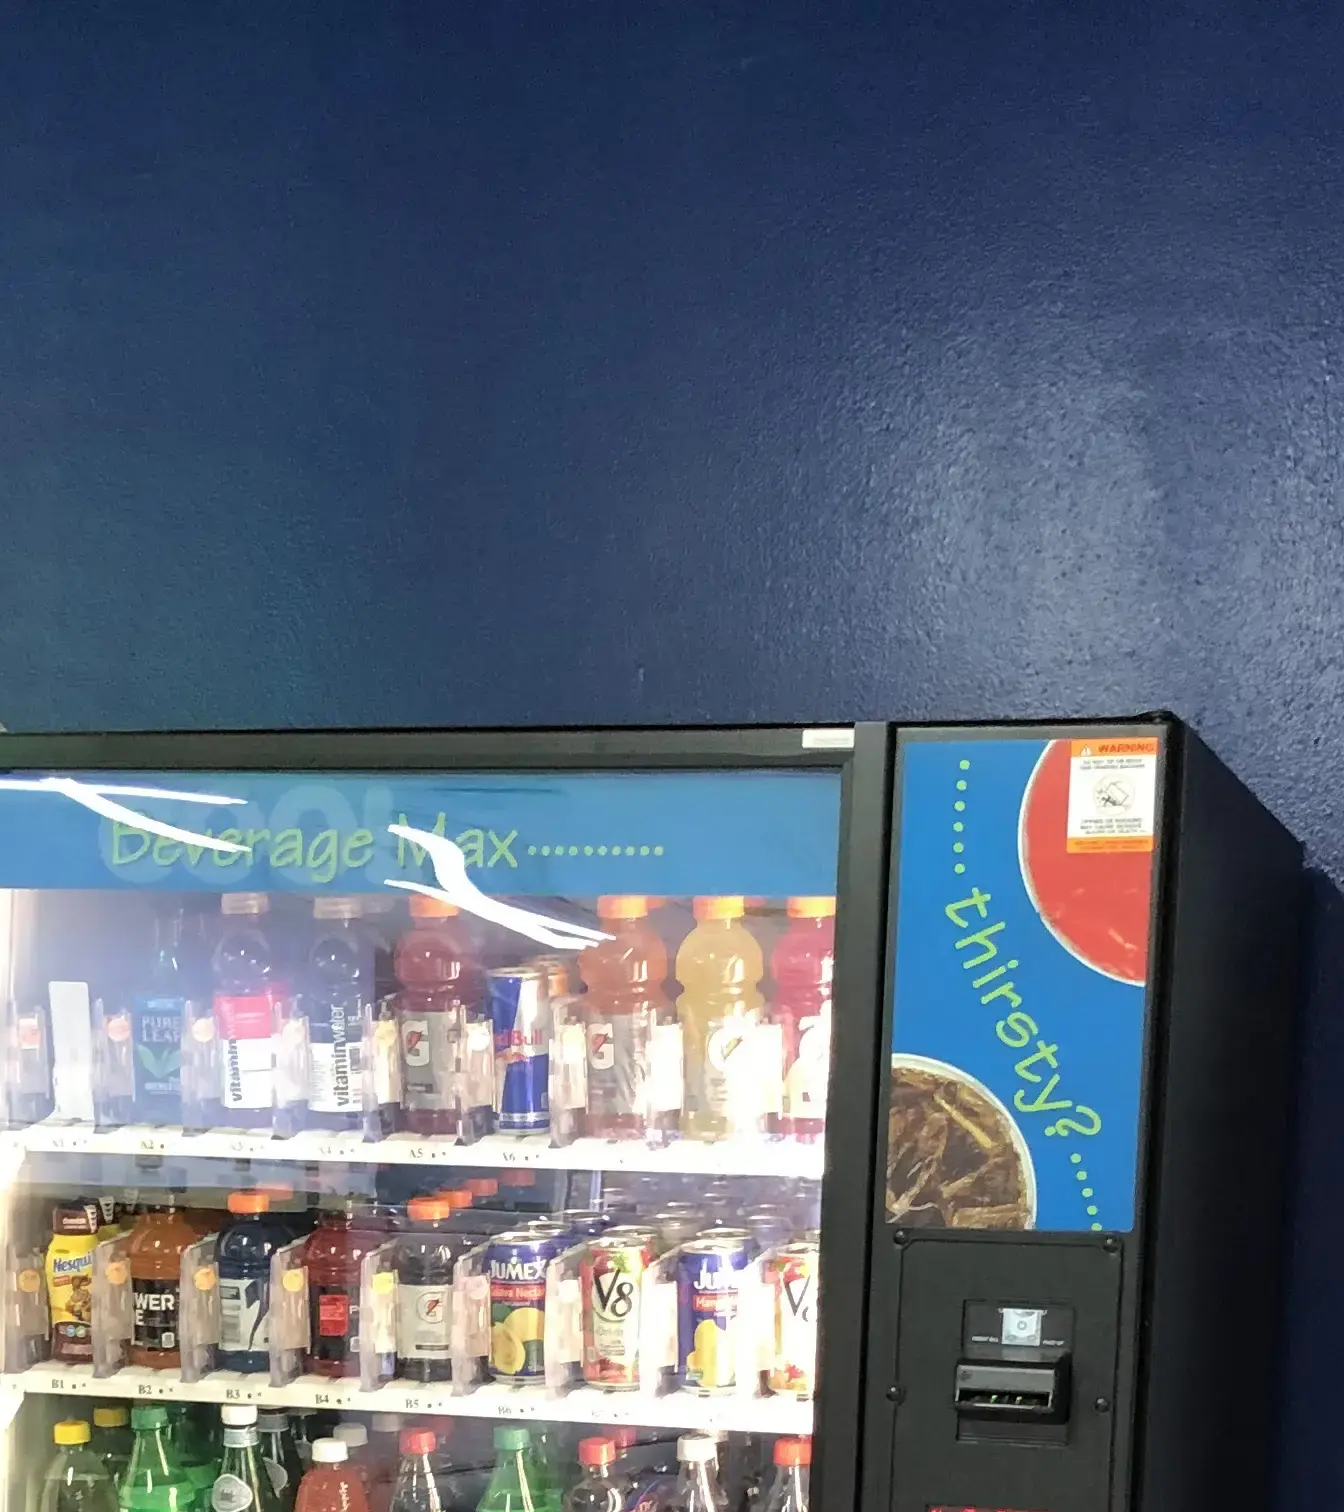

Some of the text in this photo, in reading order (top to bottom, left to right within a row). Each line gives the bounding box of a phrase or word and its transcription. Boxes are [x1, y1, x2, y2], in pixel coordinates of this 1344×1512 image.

[1098, 743, 1154, 753] WARNING
[111, 811, 518, 883] Beverage Max
[944, 887, 1101, 1137] thirsty?
[329, 1004, 350, 1107] vitaminwater
[490, 1257, 547, 1281] JUMEX
[594, 1268, 634, 1318] V8
[51, 1379, 65, 1389] B1
[138, 1384, 153, 1395] B2
[226, 1389, 241, 1399] B3
[315, 1394, 330, 1404] B4
[405, 1399, 420, 1409] B5
